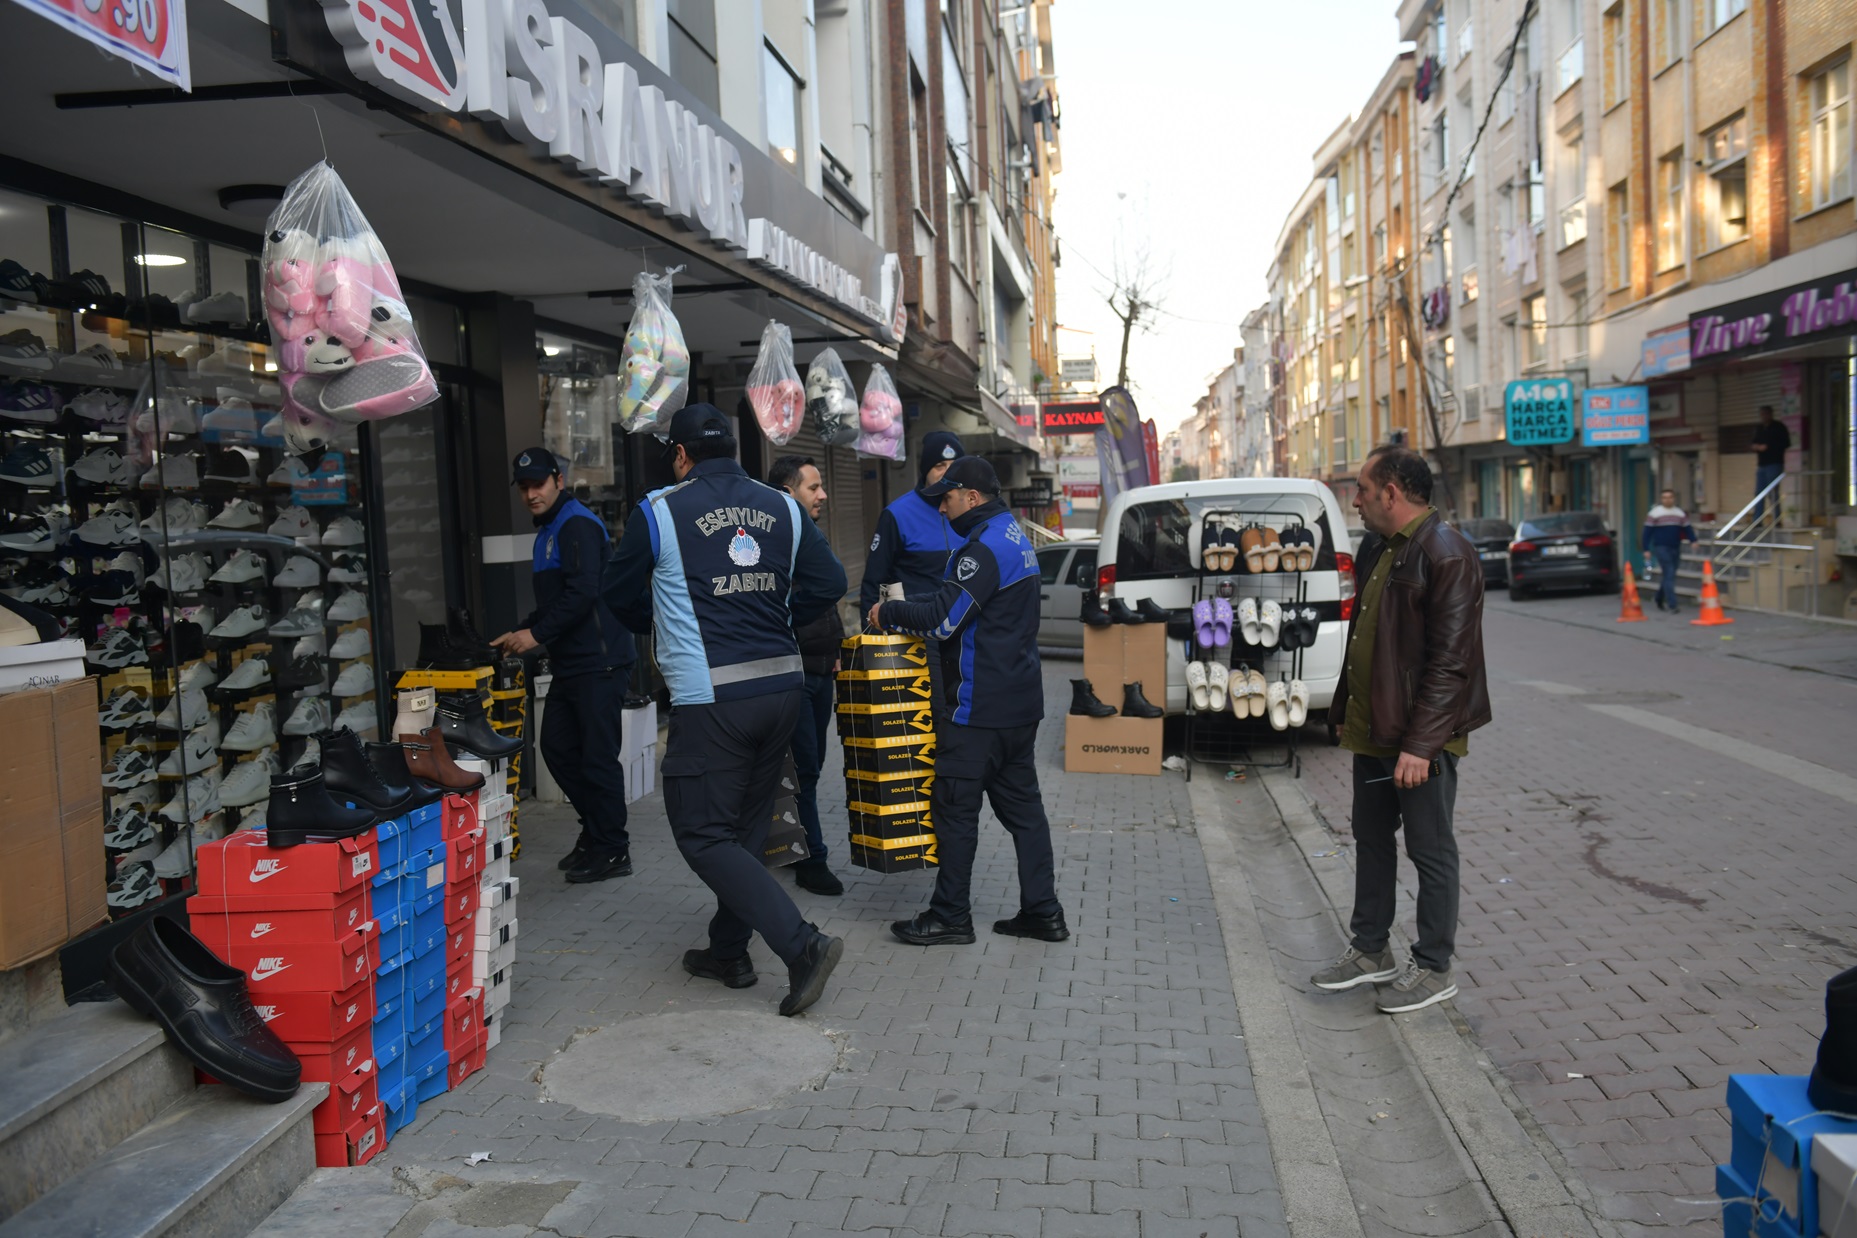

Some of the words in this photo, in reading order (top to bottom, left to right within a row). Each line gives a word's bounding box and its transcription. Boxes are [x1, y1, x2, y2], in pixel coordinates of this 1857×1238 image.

[1692, 313, 1772, 358] Zirve
[1512, 402, 1568, 413] HARCA
[1512, 414, 1568, 427] HARCA
[695, 506, 777, 537] ESENYURT
[711, 572, 777, 597] ZABITA
[881, 684, 906, 692] SOLAZER
[1082, 744, 1150, 755] DARKWORLD
[892, 818, 917, 826] SOLAZER
[895, 853, 919, 861] SOLAZER
[255, 859, 280, 872] NIKE
[255, 922, 271, 931] NIKE
[257, 957, 284, 970] NIKE
